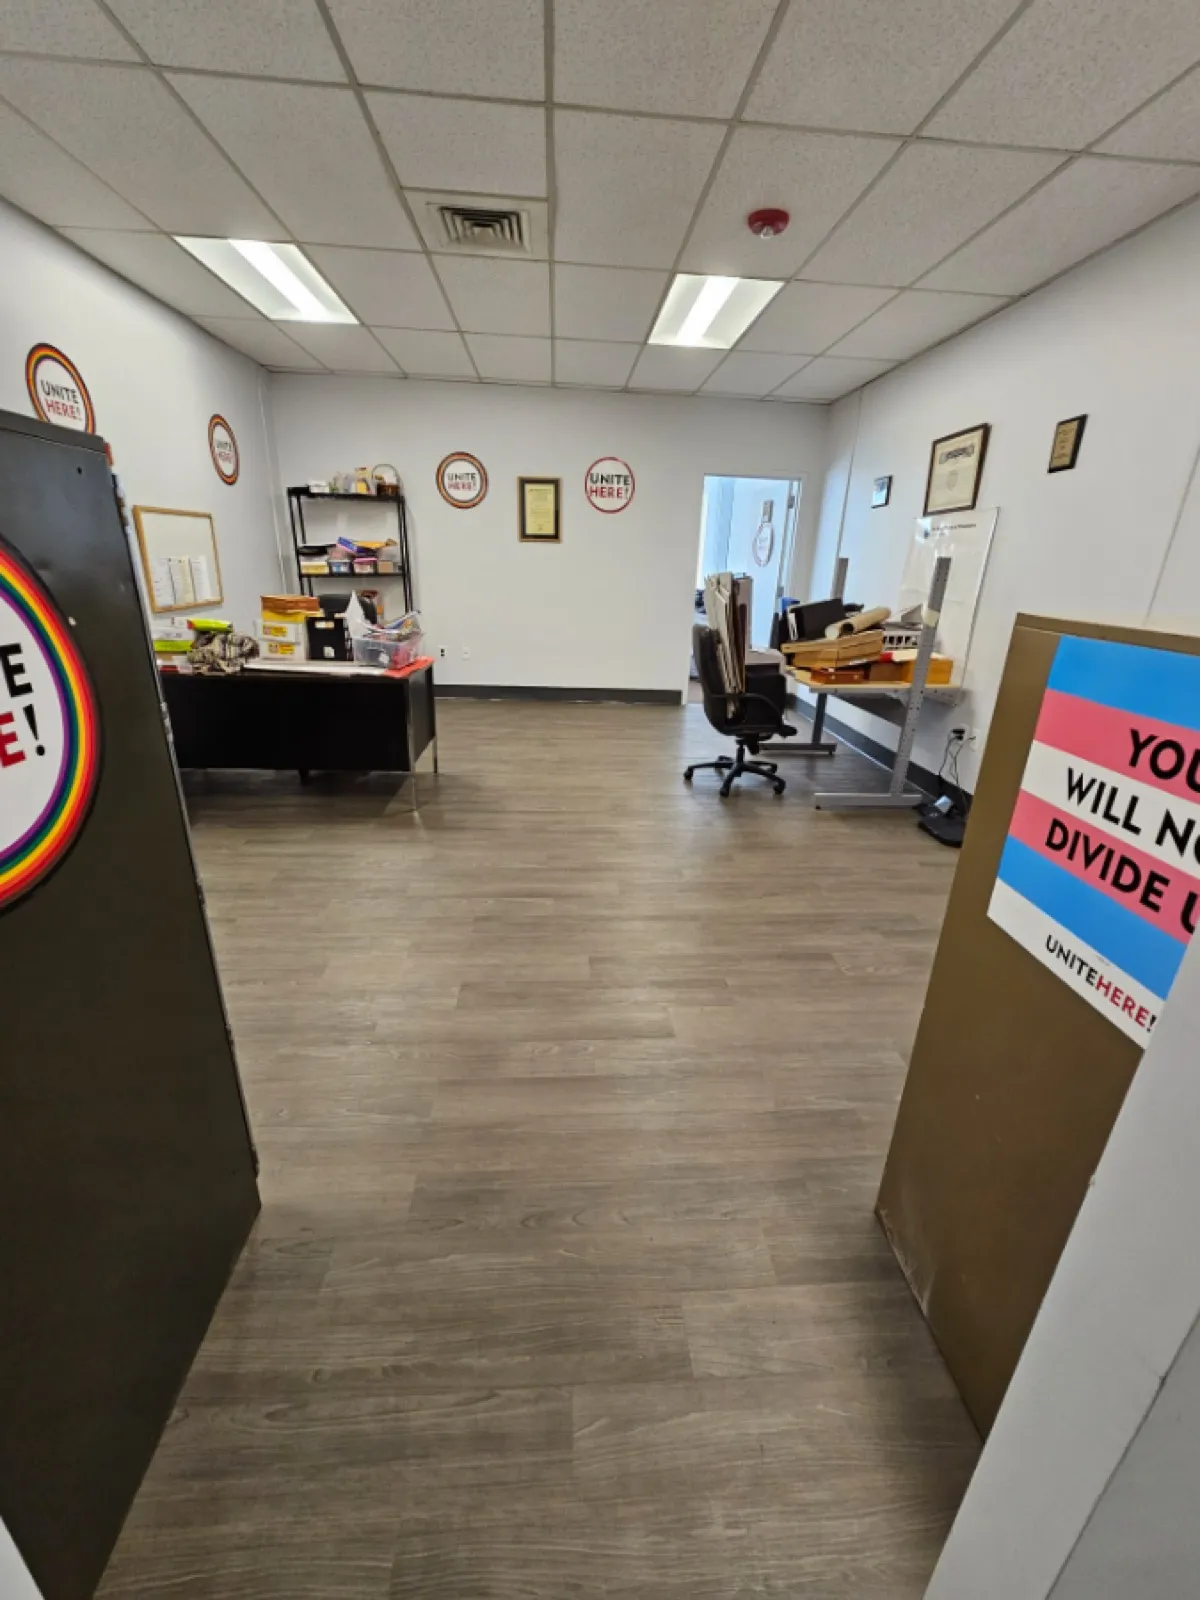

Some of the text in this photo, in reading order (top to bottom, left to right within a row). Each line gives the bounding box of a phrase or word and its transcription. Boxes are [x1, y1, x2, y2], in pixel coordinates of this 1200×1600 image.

[41, 379, 79, 404] UNITE
[590, 472, 630, 486] UNITE
[590, 485, 629, 500] HERE!
[1067, 766, 1142, 836] WILL
[1045, 817, 1170, 913] DIVIDE
